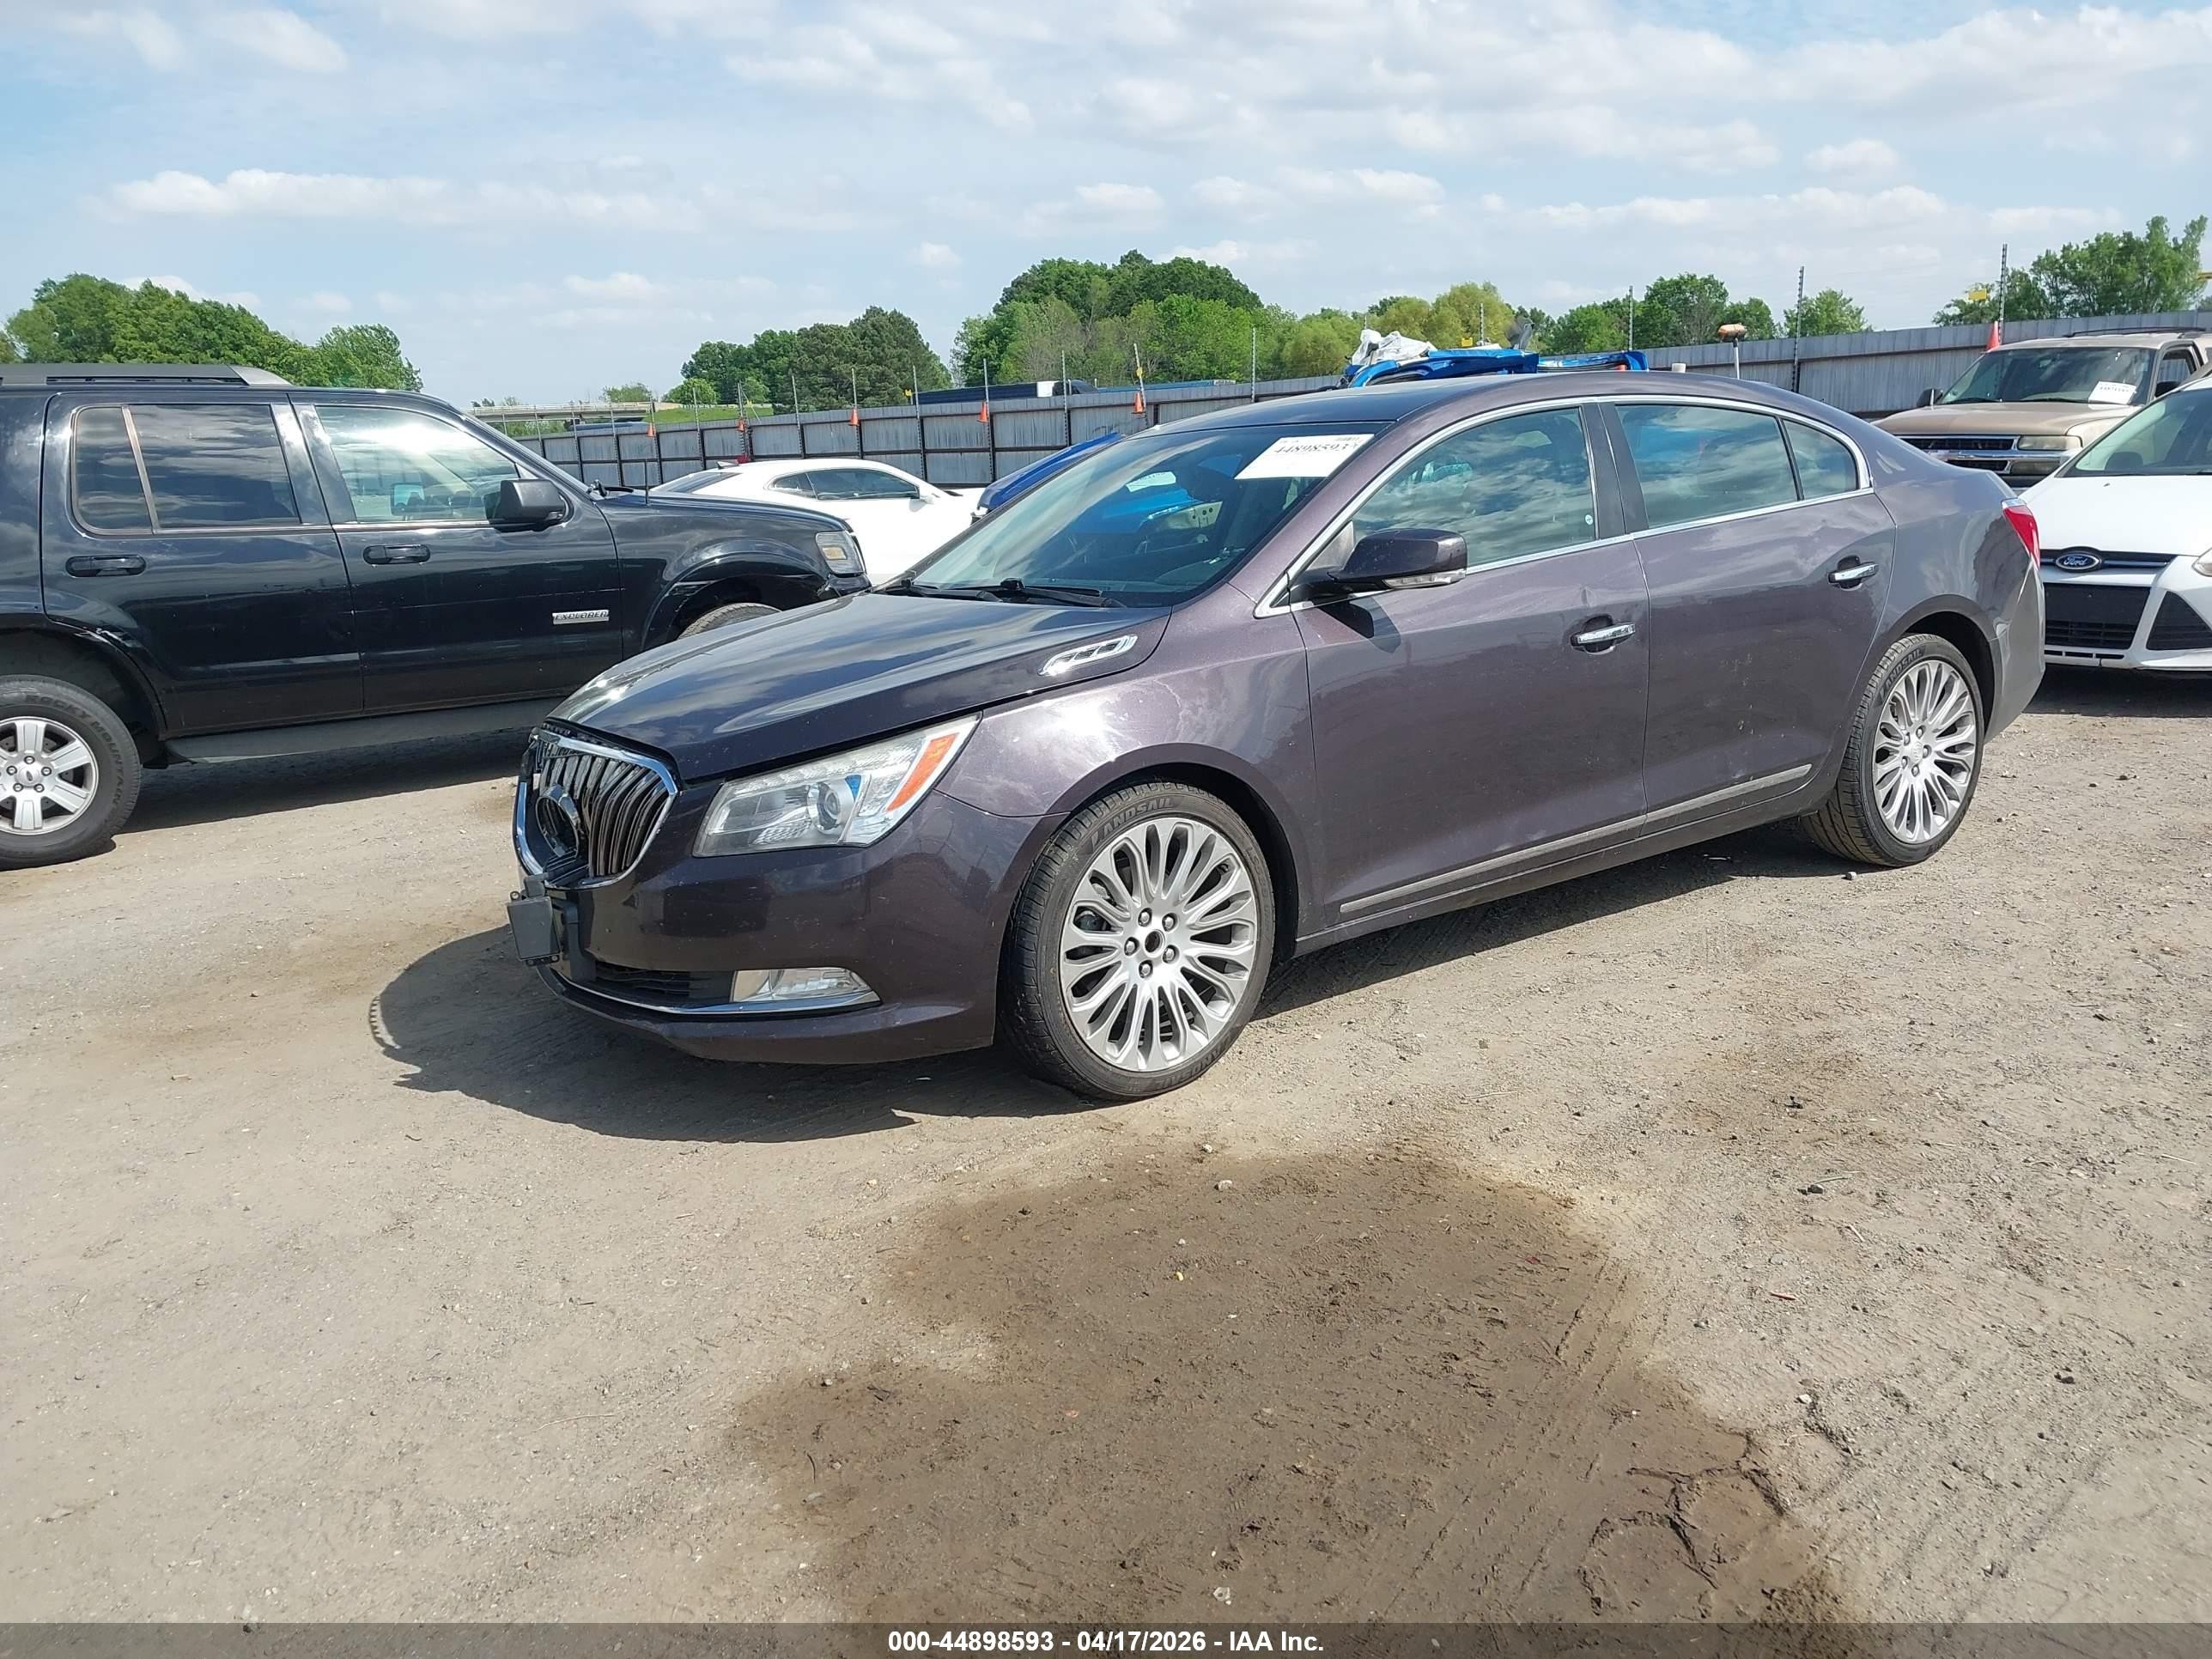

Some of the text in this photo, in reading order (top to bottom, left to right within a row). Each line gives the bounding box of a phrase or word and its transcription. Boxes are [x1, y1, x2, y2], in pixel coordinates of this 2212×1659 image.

[2063, 556, 2087, 566] Ford
[555, 611, 608, 620] EXPLORER
[1879, 648, 1923, 699] LANDSAIL
[25, 695, 125, 804] ROCKY MOUNTAIN
[1091, 798, 1174, 848] LANDSAIL
